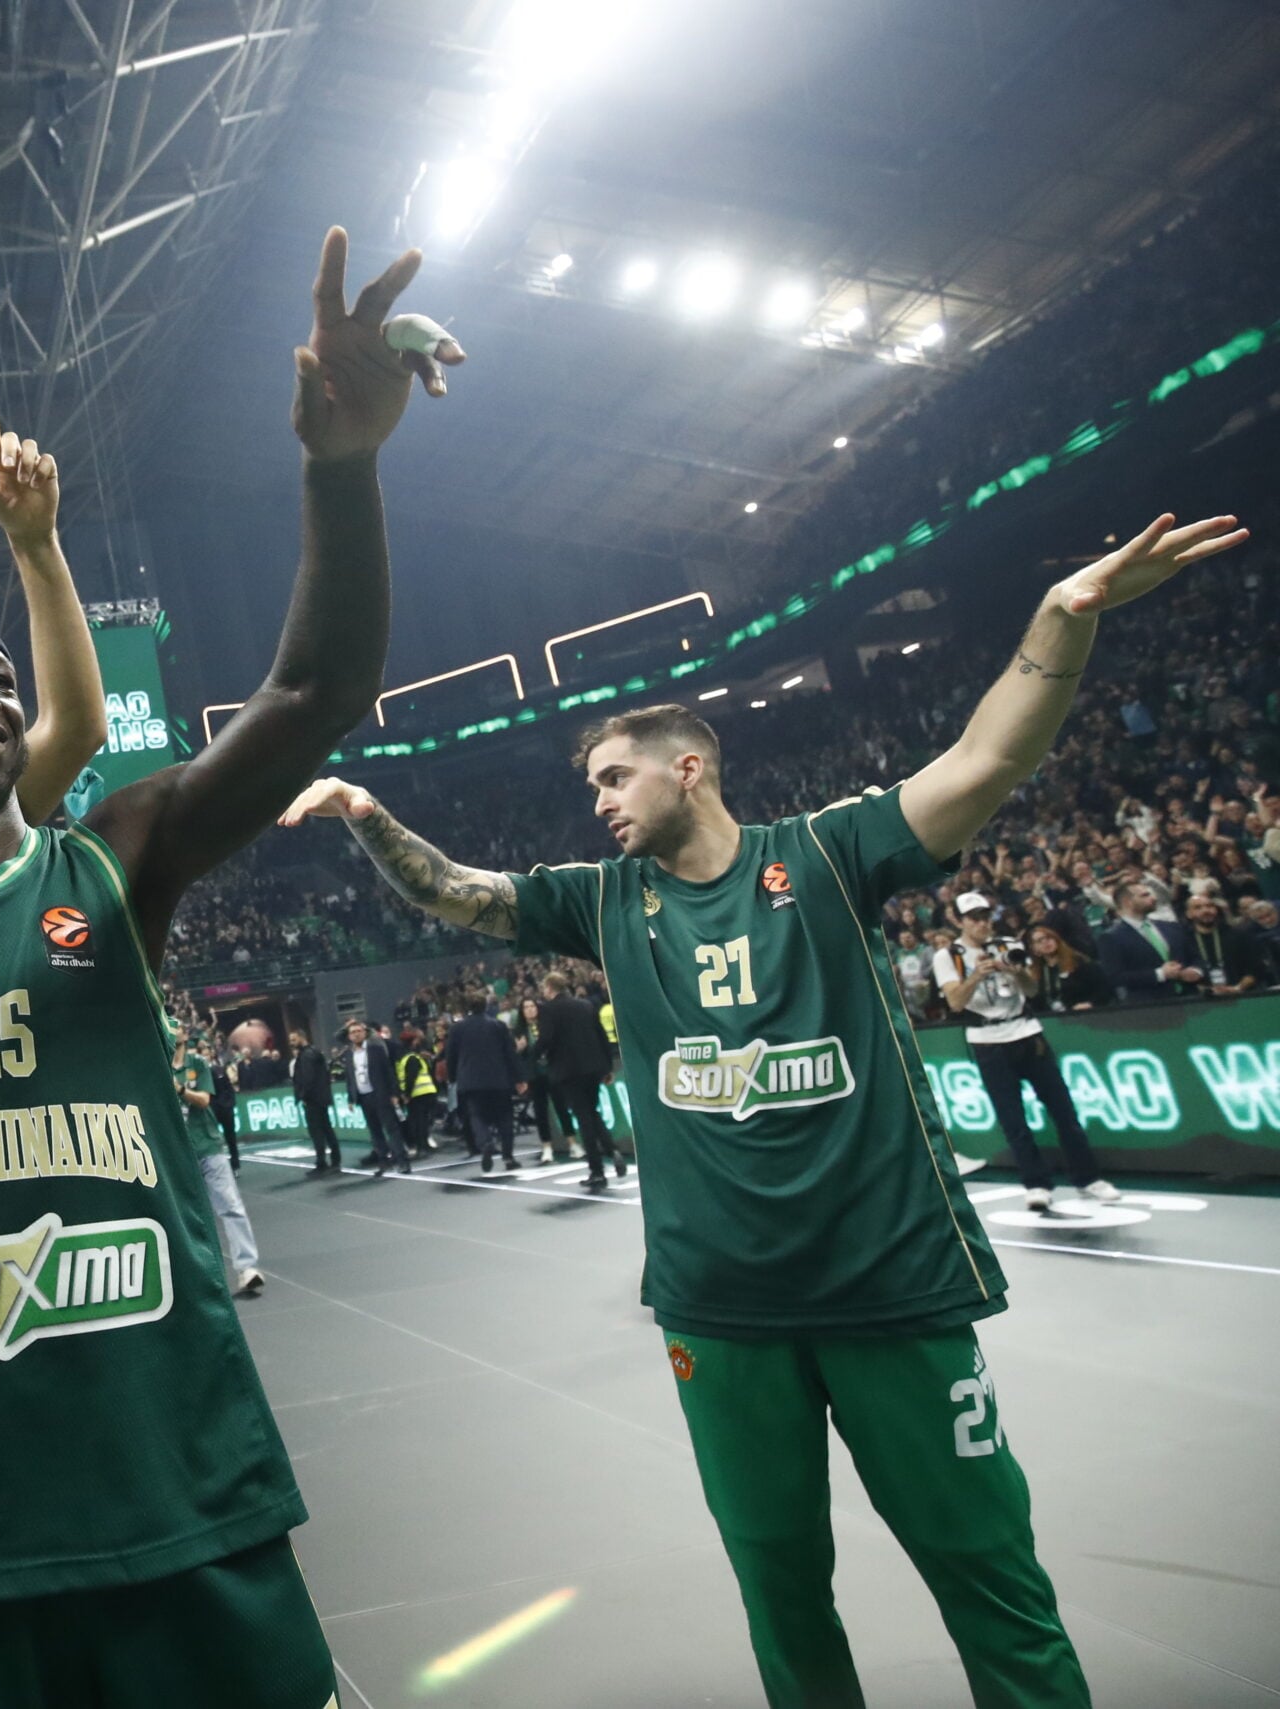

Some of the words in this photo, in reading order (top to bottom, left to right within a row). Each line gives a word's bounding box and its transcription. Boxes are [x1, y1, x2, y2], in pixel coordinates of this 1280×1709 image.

[104, 690, 152, 724] AO
[96, 718, 169, 755] INS
[694, 934, 758, 1008] 27
[1021, 1050, 1181, 1131] AO
